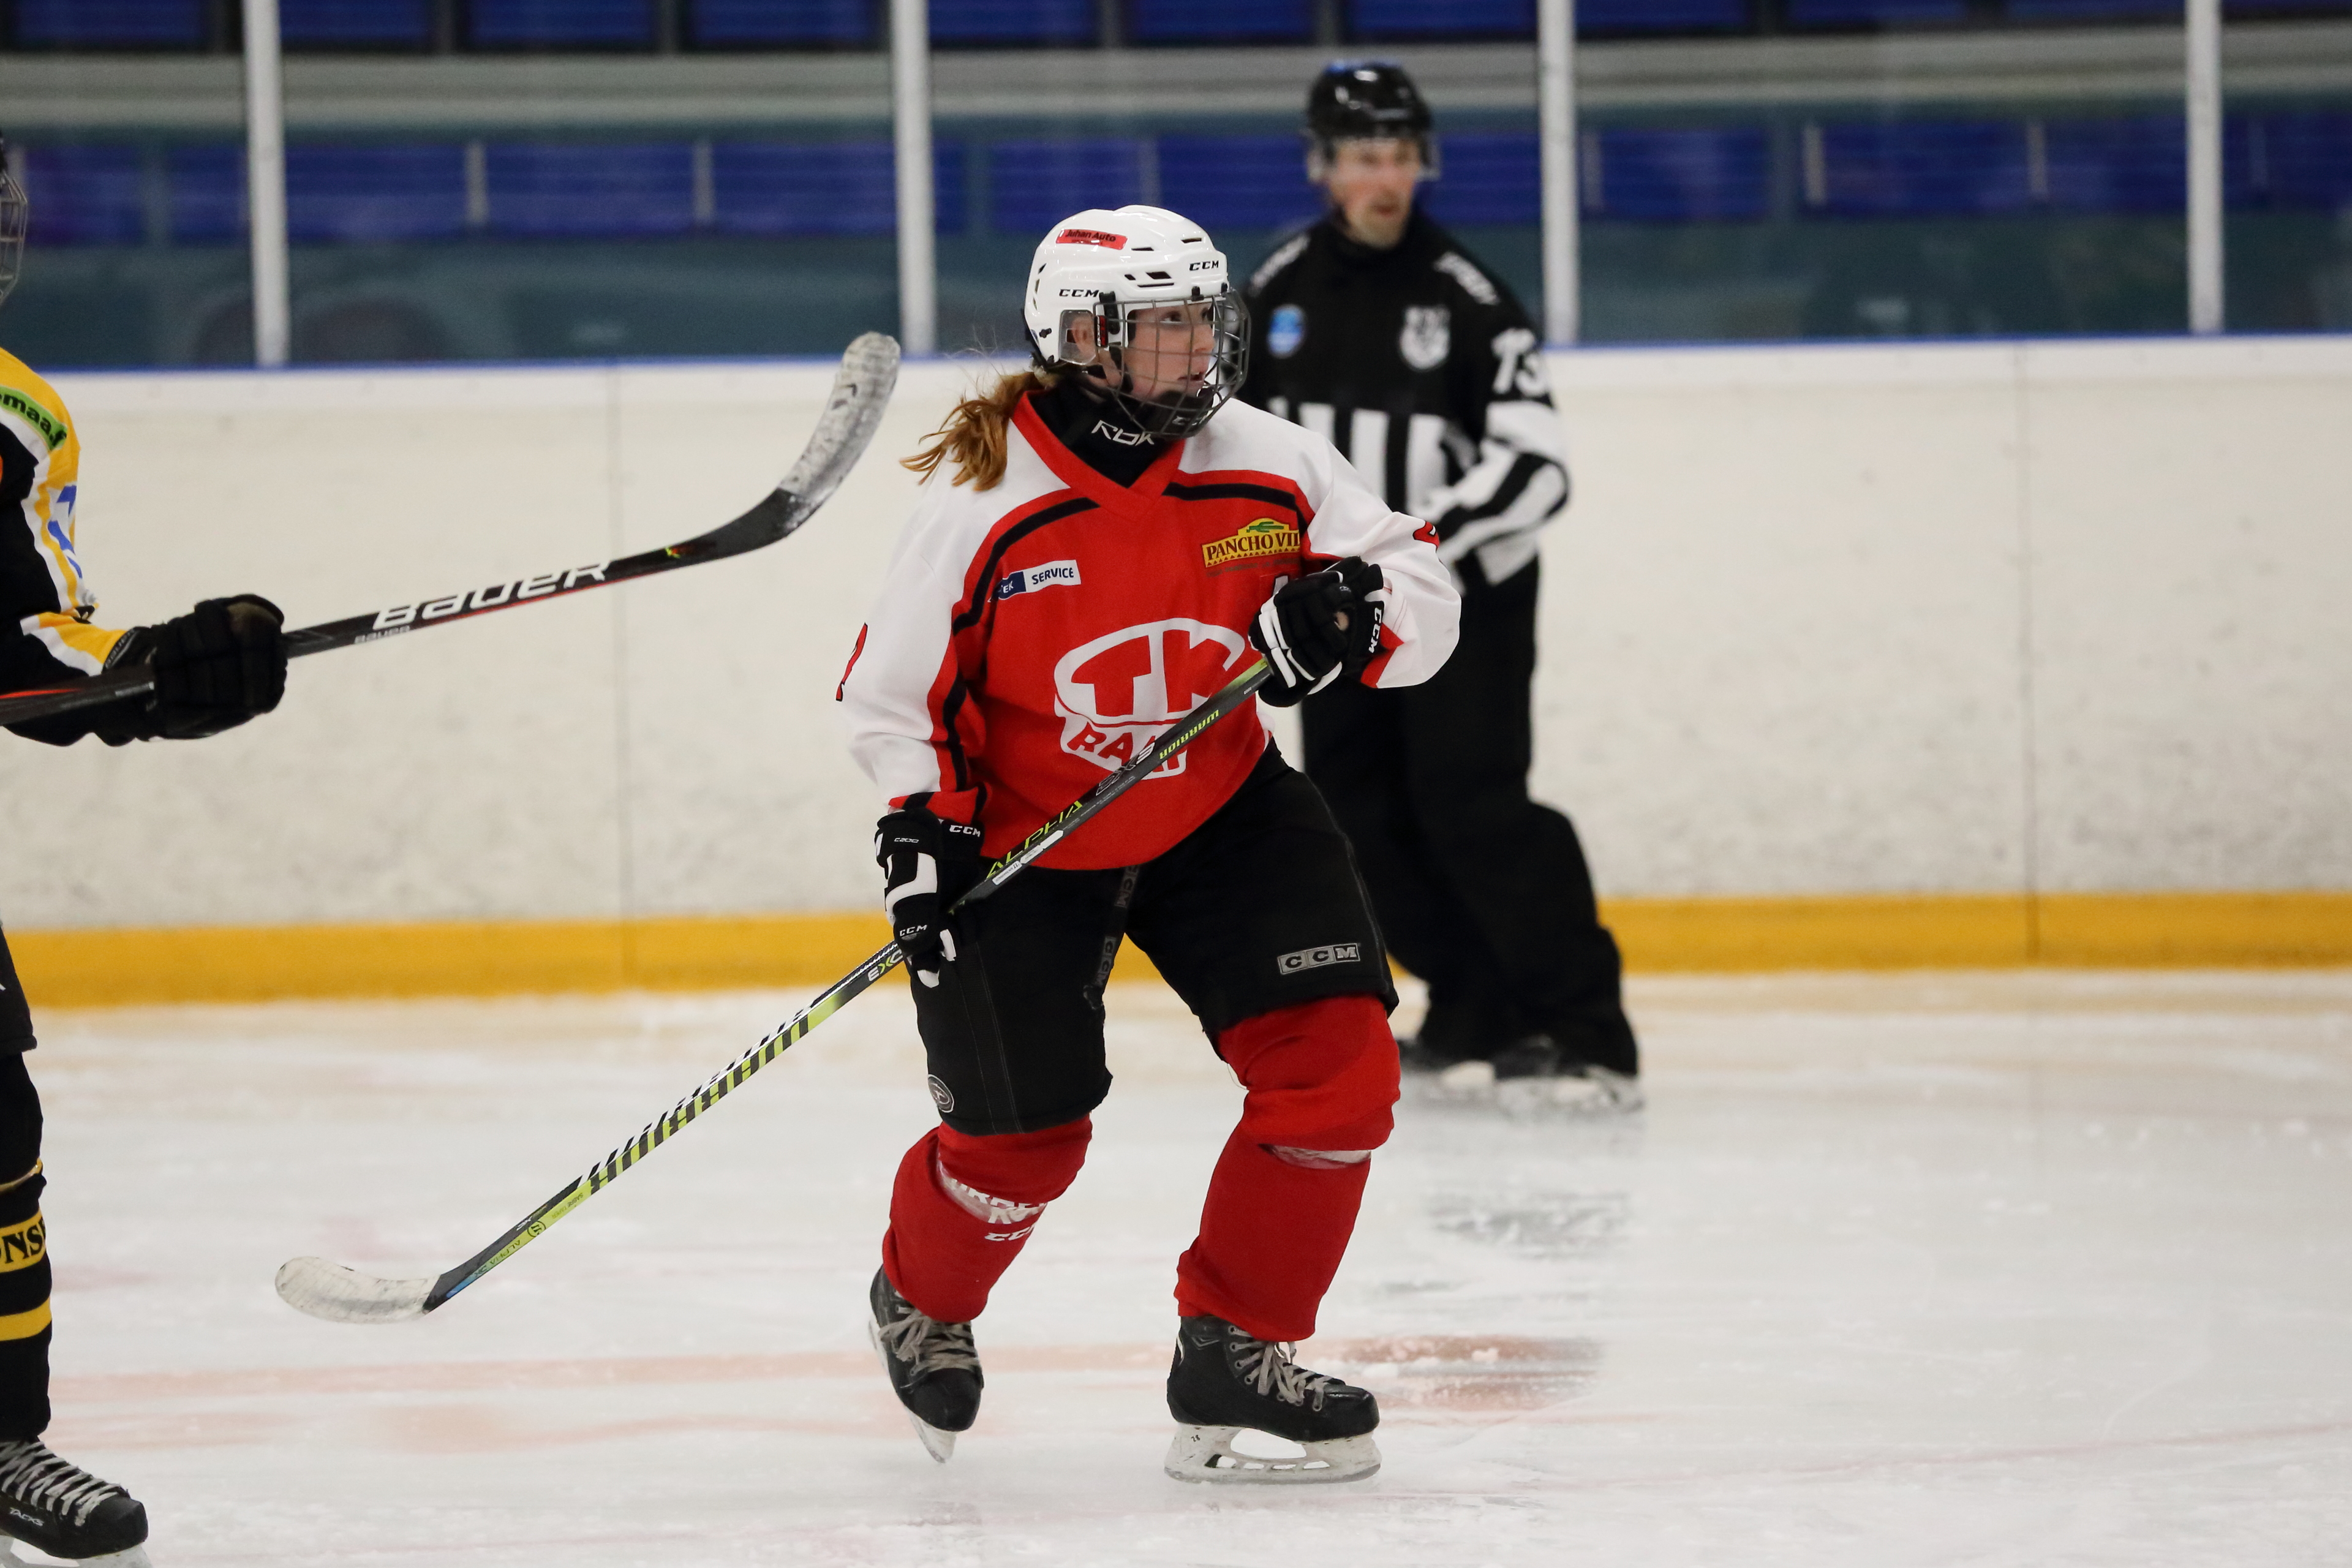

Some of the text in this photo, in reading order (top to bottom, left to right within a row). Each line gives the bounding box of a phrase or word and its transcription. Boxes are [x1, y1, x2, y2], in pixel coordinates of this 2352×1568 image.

[1065, 229, 1091, 238] Juhan
[1091, 232, 1116, 242] Auto
[1189, 260, 1219, 271] CCM
[1058, 288, 1099, 298] CCM
[1206, 534, 1274, 560] PANCHO
[1000, 567, 1074, 594] EK SERVICE
[372, 560, 612, 630] BAUER
[1368, 607, 1382, 653] CCM
[1159, 709, 1219, 760] WARRIOR
[949, 824, 981, 838] CCM
[986, 800, 1082, 879] ALPHA
[899, 924, 927, 937] CCM
[1284, 946, 1359, 970] CCM
[489, 1239, 521, 1265] ALPHA
